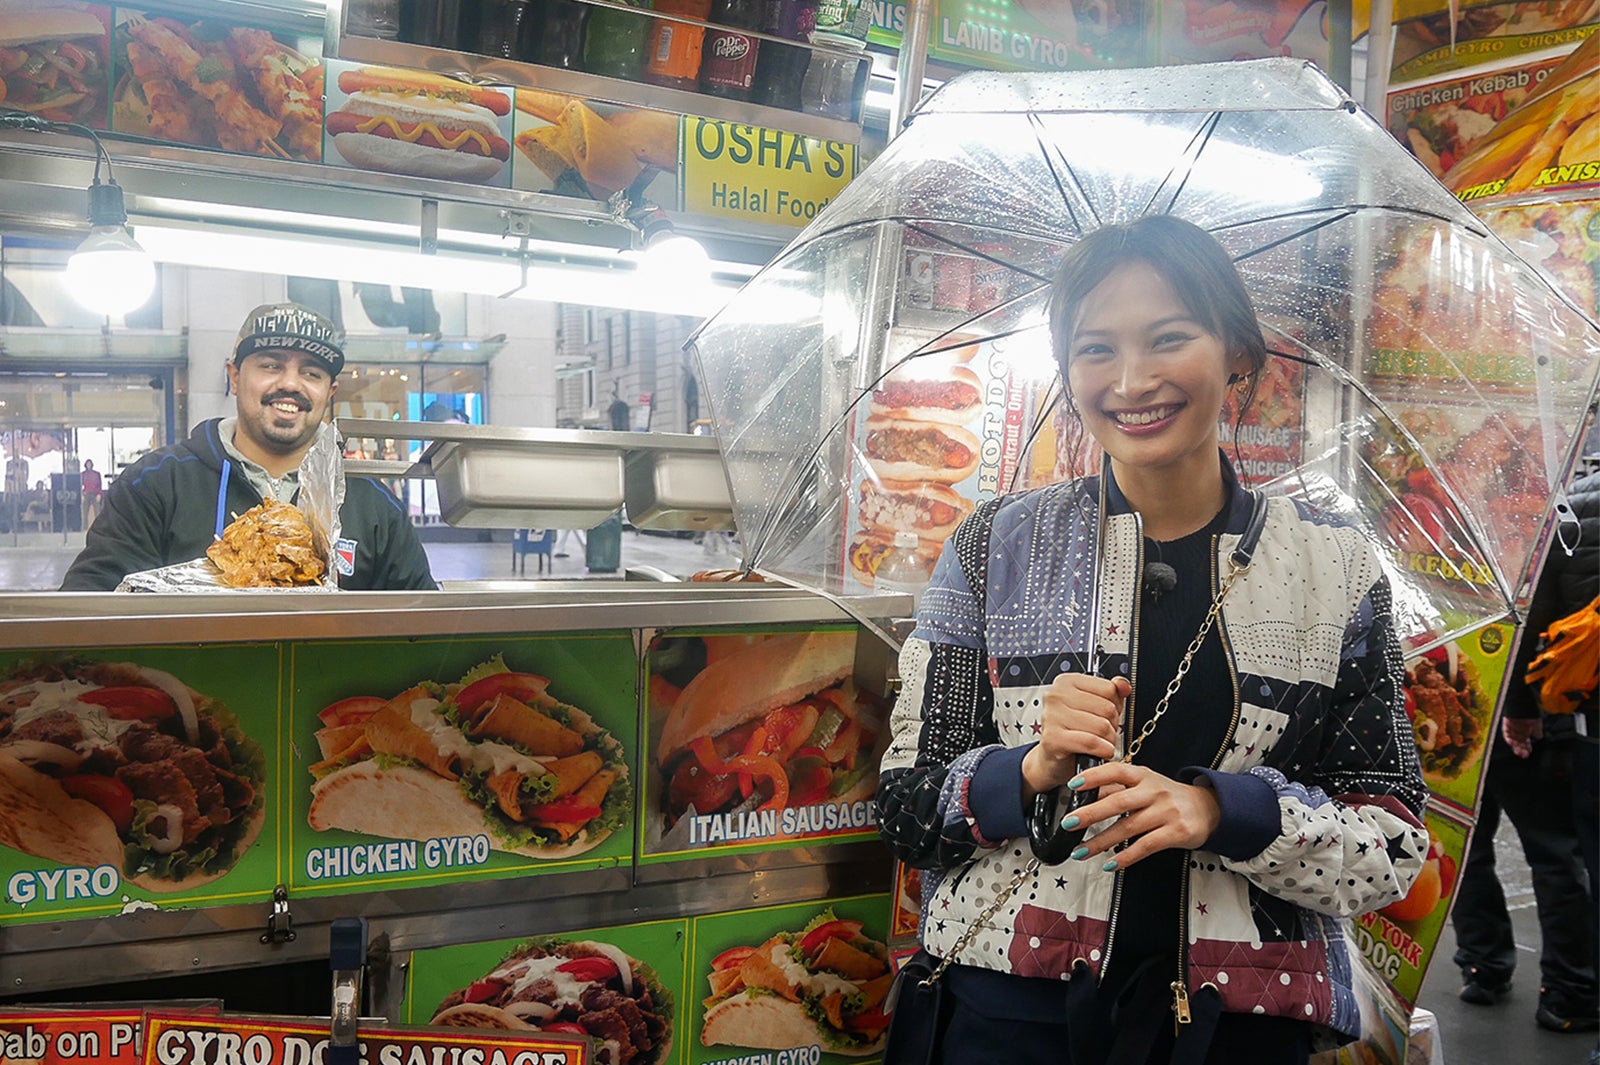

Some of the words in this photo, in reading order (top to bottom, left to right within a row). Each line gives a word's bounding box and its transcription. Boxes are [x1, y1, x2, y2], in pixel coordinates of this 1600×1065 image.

[713, 37, 748, 57] Pepper
[726, 35, 740, 48] Dr
[942, 17, 1004, 54] LAMB
[1010, 31, 1069, 68] GYRO
[1455, 40, 1505, 55] GYRO
[1519, 28, 1588, 48] CHICKEN
[1392, 86, 1464, 112] Chicken
[1469, 70, 1530, 97] Kebab
[695, 117, 845, 178] OSHA'S
[1533, 161, 1600, 187] KNIS
[712, 182, 768, 213] Halal
[254, 335, 299, 348] NEW
[299, 338, 340, 364] YORK
[977, 411, 1004, 494] HOT
[689, 809, 777, 844] ITALIAN
[782, 801, 877, 834] SAUSAGE
[306, 841, 418, 879] CHICKEN
[424, 835, 490, 868] GYRO
[8, 865, 120, 904] GYRO
[1357, 927, 1401, 983] DOG
[1380, 917, 1424, 970] YORK
[57, 1031, 99, 1058] on
[156, 1029, 274, 1065] GYRO
[380, 1043, 568, 1065] SAUS
[776, 1045, 820, 1065] GYRO
